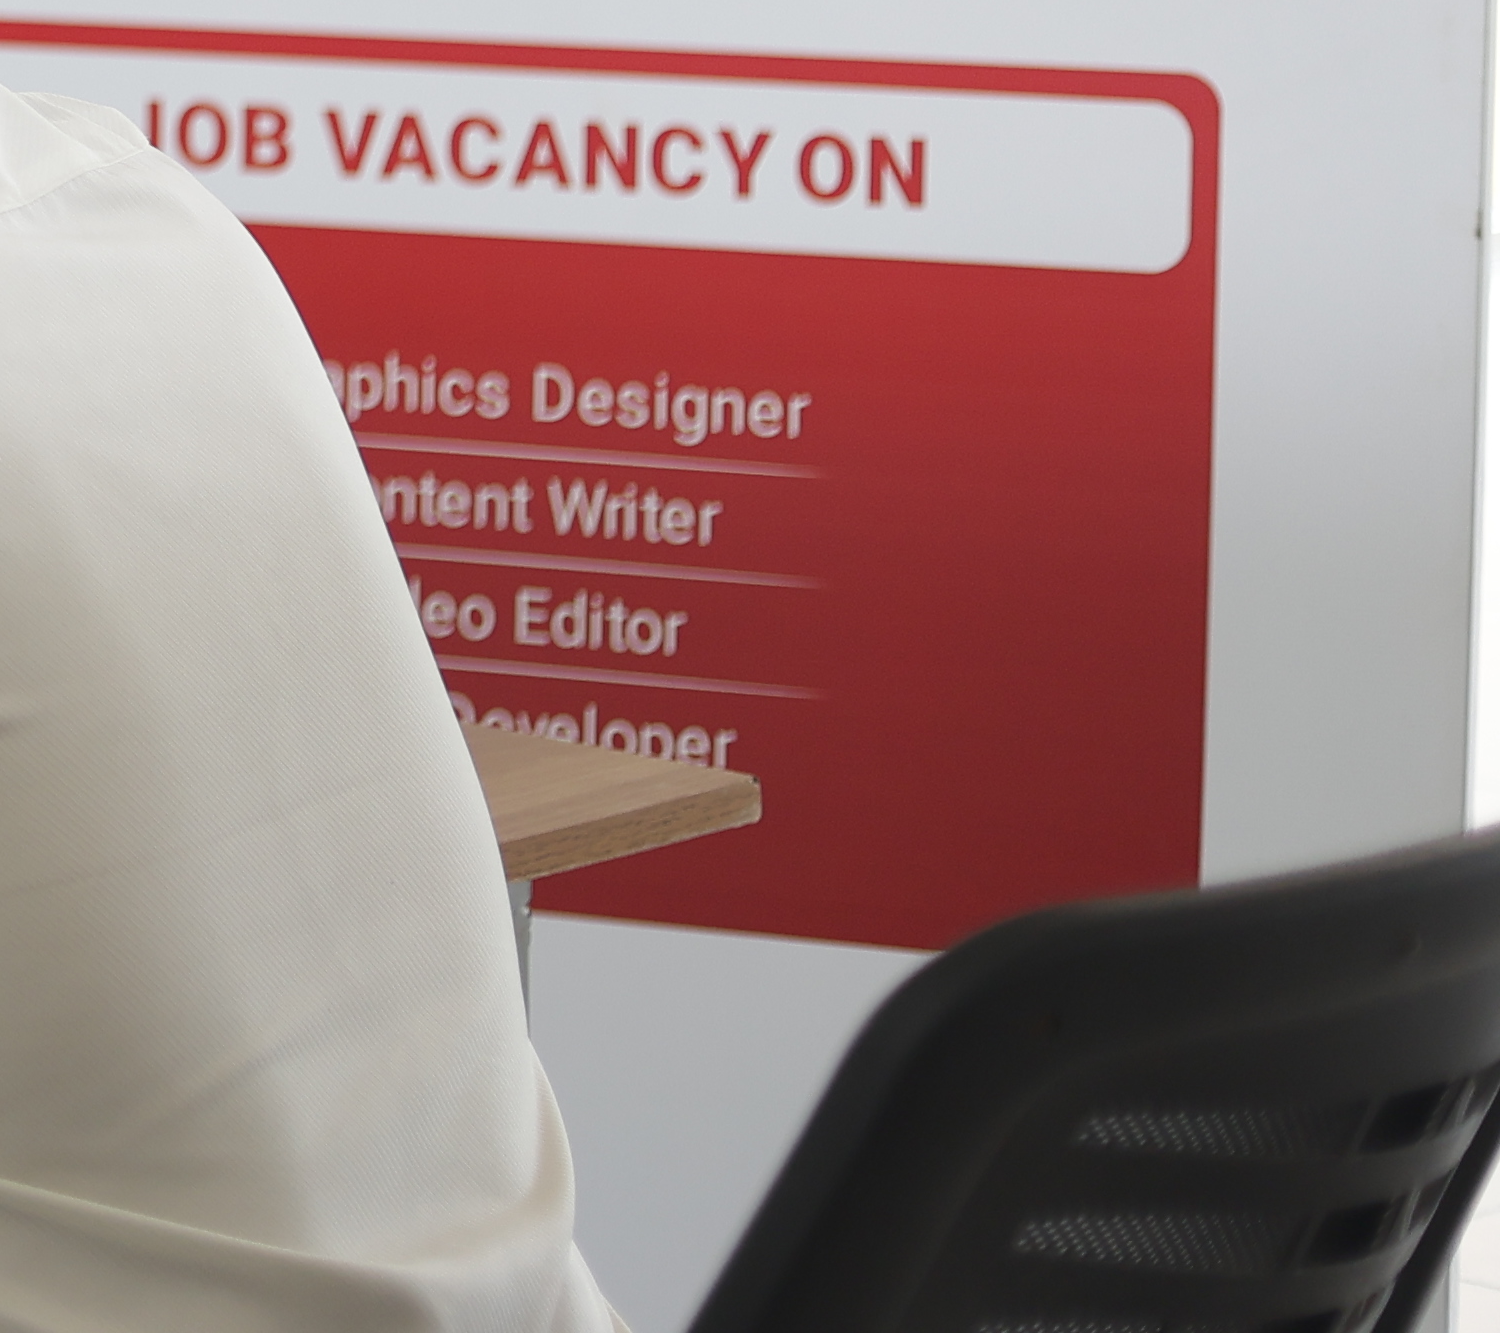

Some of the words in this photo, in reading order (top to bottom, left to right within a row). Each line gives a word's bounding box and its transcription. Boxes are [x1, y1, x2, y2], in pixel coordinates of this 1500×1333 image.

[325, 107, 772, 201] VACANCY
[797, 134, 926, 209] ON
[532, 362, 813, 447] Designer
[371, 470, 534, 533] ntent
[547, 474, 724, 547] Writer
[513, 585, 690, 657] Editor
